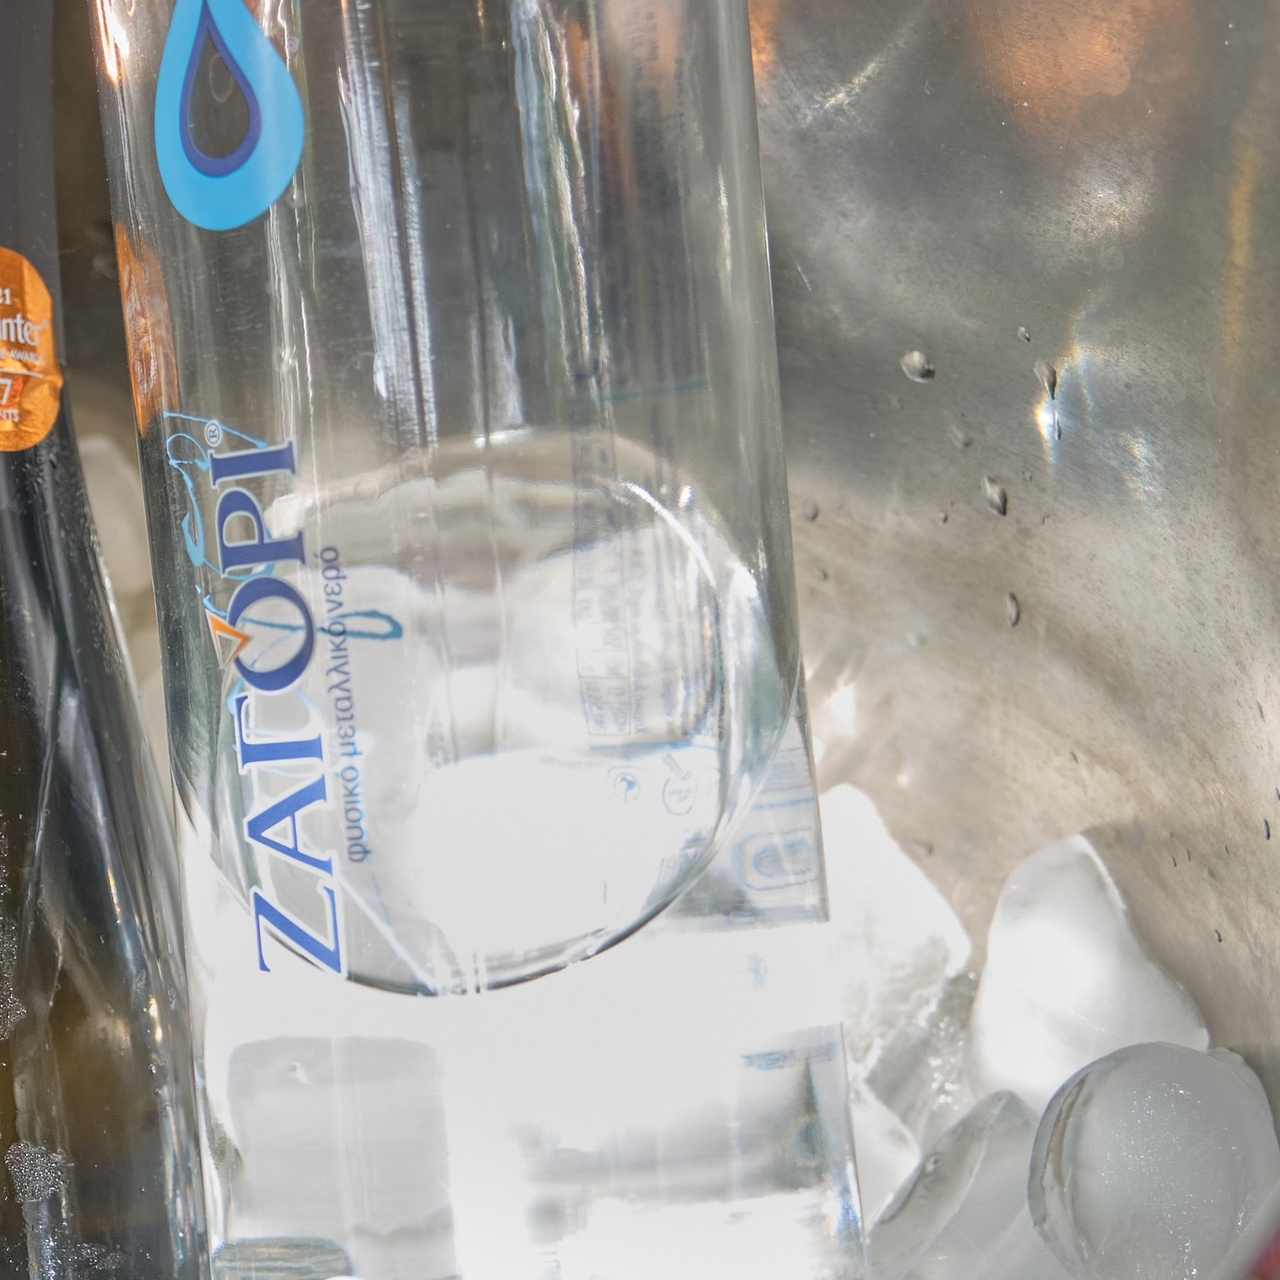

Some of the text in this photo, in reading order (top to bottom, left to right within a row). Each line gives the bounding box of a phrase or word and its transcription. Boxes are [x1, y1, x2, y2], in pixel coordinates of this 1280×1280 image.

[313, 544, 373, 864] φυσικό μεταλλικό νερό
